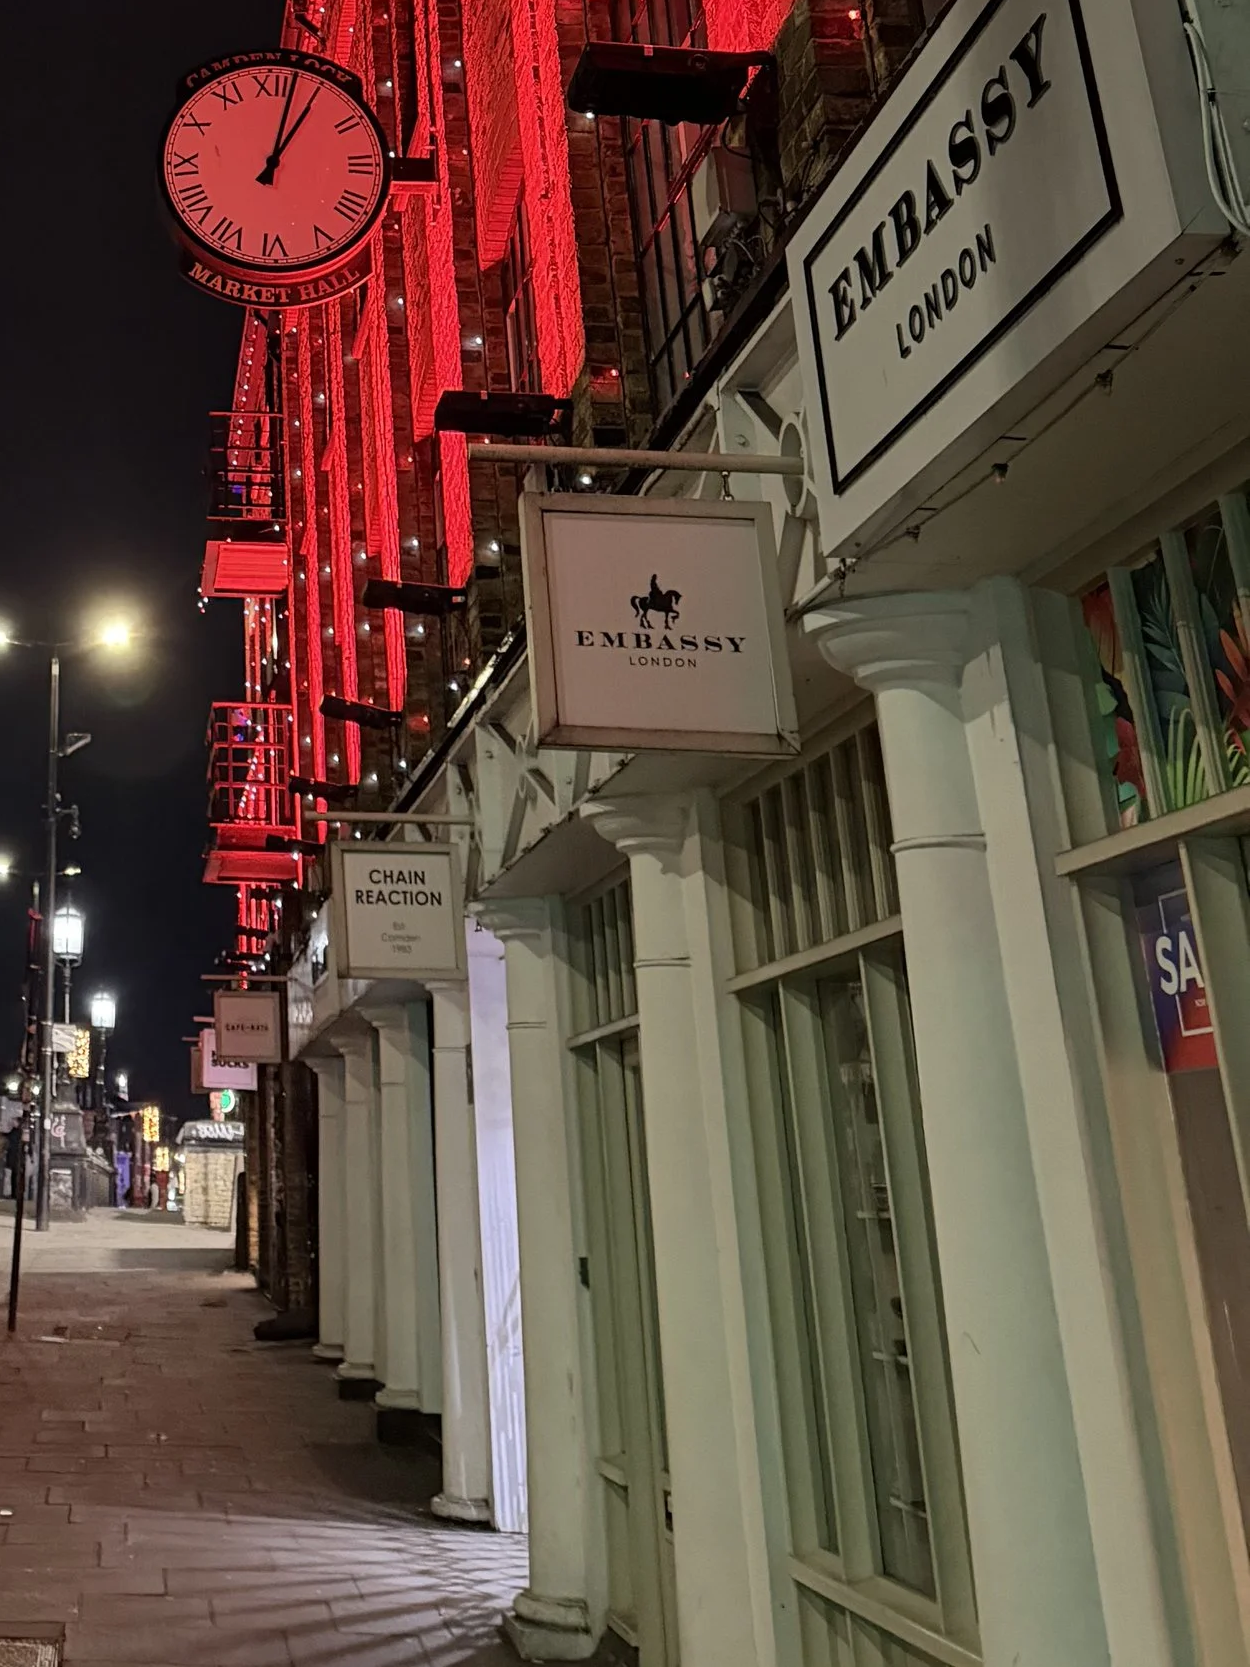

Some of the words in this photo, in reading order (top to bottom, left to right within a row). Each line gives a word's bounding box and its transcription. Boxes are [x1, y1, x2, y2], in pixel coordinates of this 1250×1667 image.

[827, 13, 1051, 342] EMBASSY
[188, 262, 290, 303] MARKET
[299, 267, 360, 301] HALL
[895, 223, 998, 359] LONDON
[575, 630, 746, 654] EMBASSY
[629, 656, 697, 668] LONDON
[369, 869, 425, 885] CHAIN
[355, 890, 442, 906] REACTION
